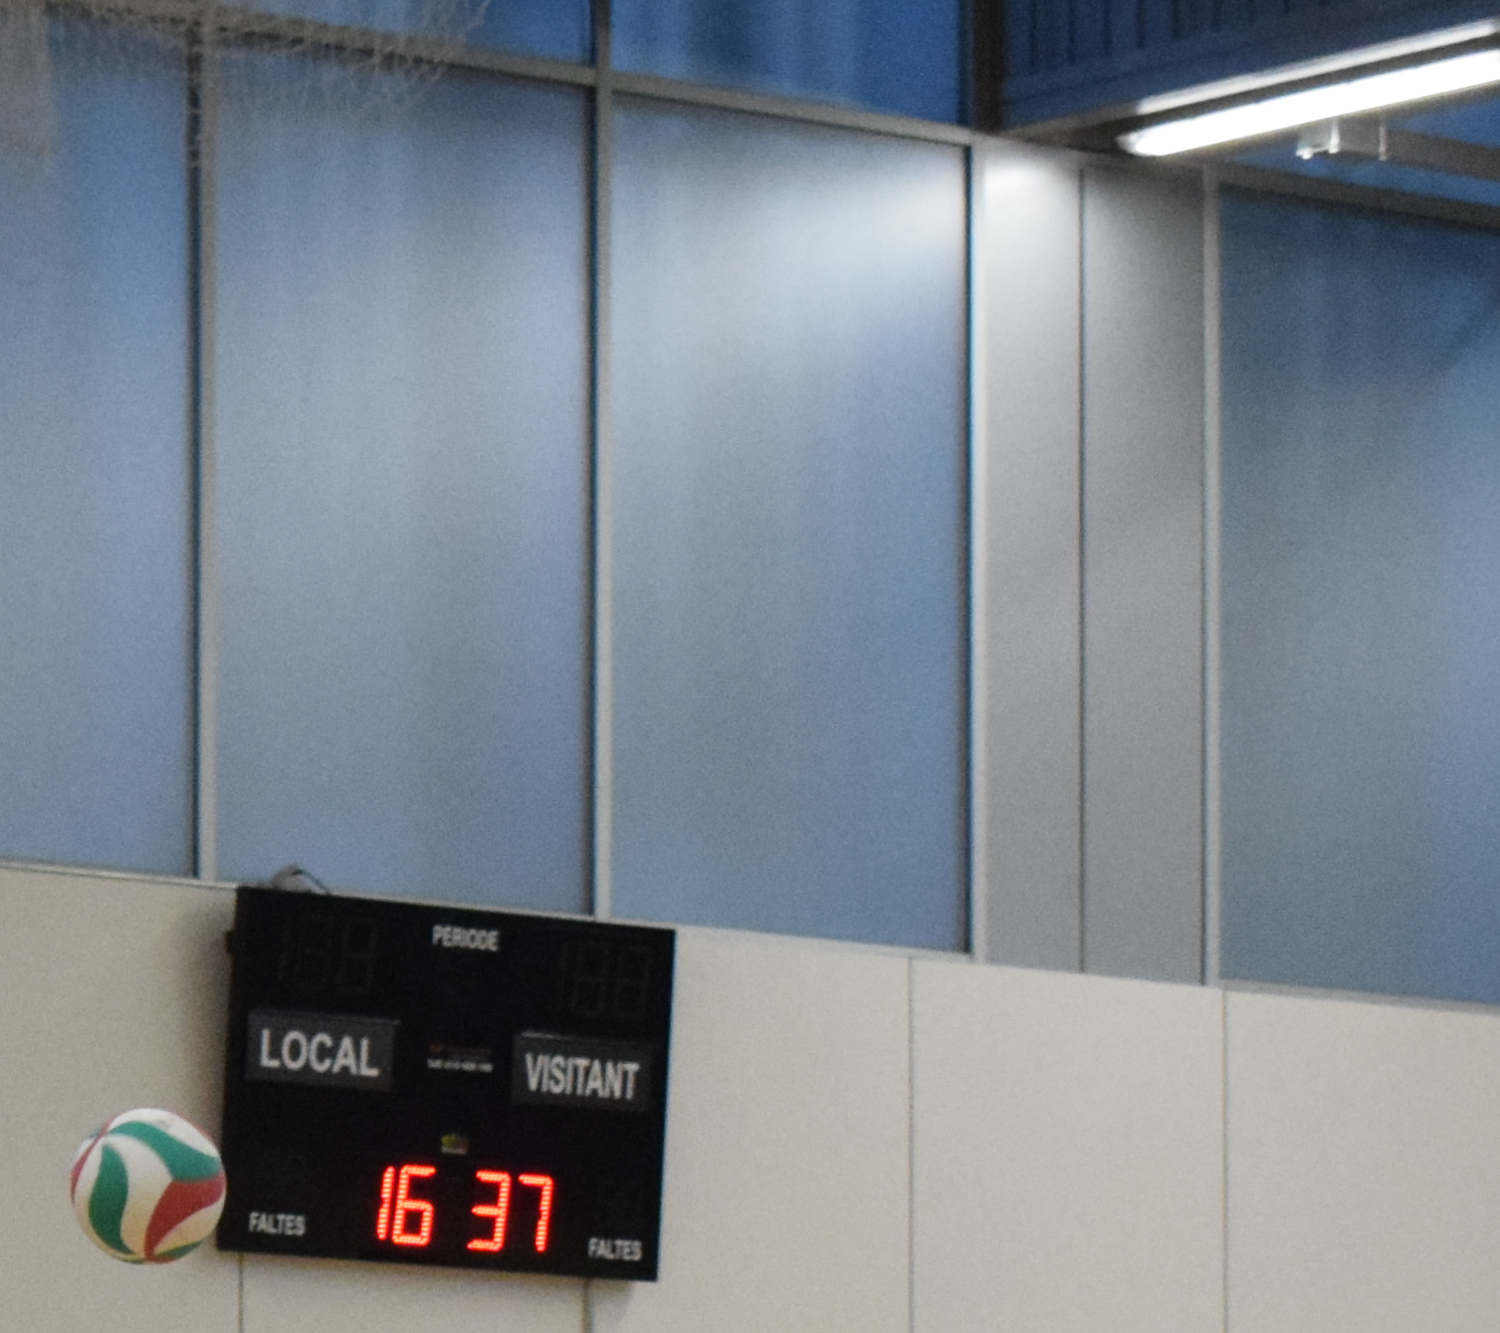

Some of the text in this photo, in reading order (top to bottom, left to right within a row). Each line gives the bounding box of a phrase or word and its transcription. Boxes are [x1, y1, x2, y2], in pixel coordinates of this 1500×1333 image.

[432, 925, 499, 951] PERIODE
[259, 1028, 379, 1078] LOCAL
[525, 1053, 640, 1101] VISITANT
[249, 1211, 306, 1237] FALTES
[376, 1164, 554, 1252] 16 37
[588, 1237, 642, 1263] FALTES
